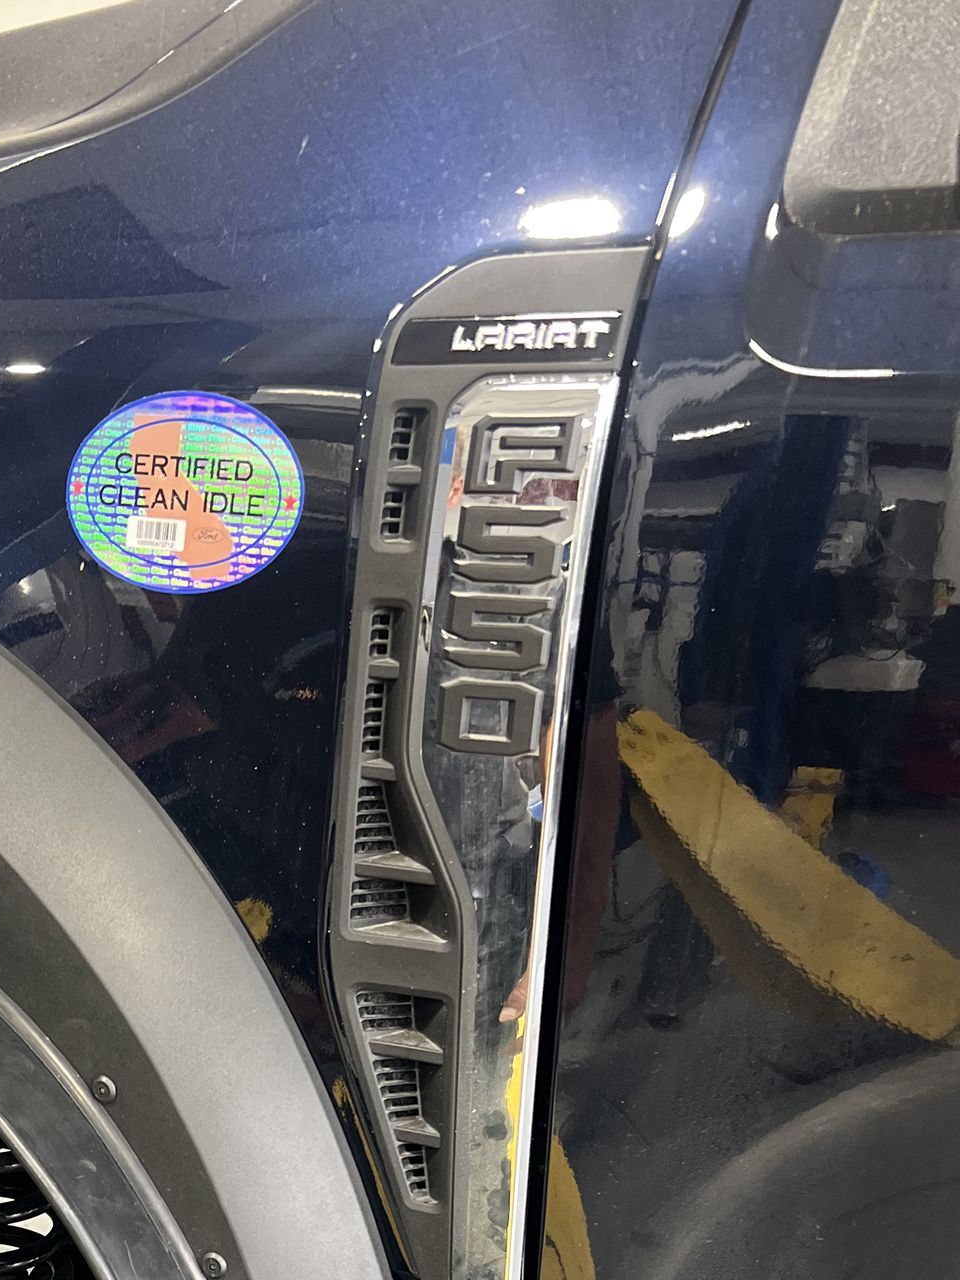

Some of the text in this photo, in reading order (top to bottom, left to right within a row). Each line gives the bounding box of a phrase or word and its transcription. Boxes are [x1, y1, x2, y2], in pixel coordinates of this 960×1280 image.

[451, 320, 611, 351] LARIAT
[114, 453, 254, 482] CERTIFIED
[99, 484, 266, 517] CLEAN IDLE
[438, 413, 582, 758] F550
